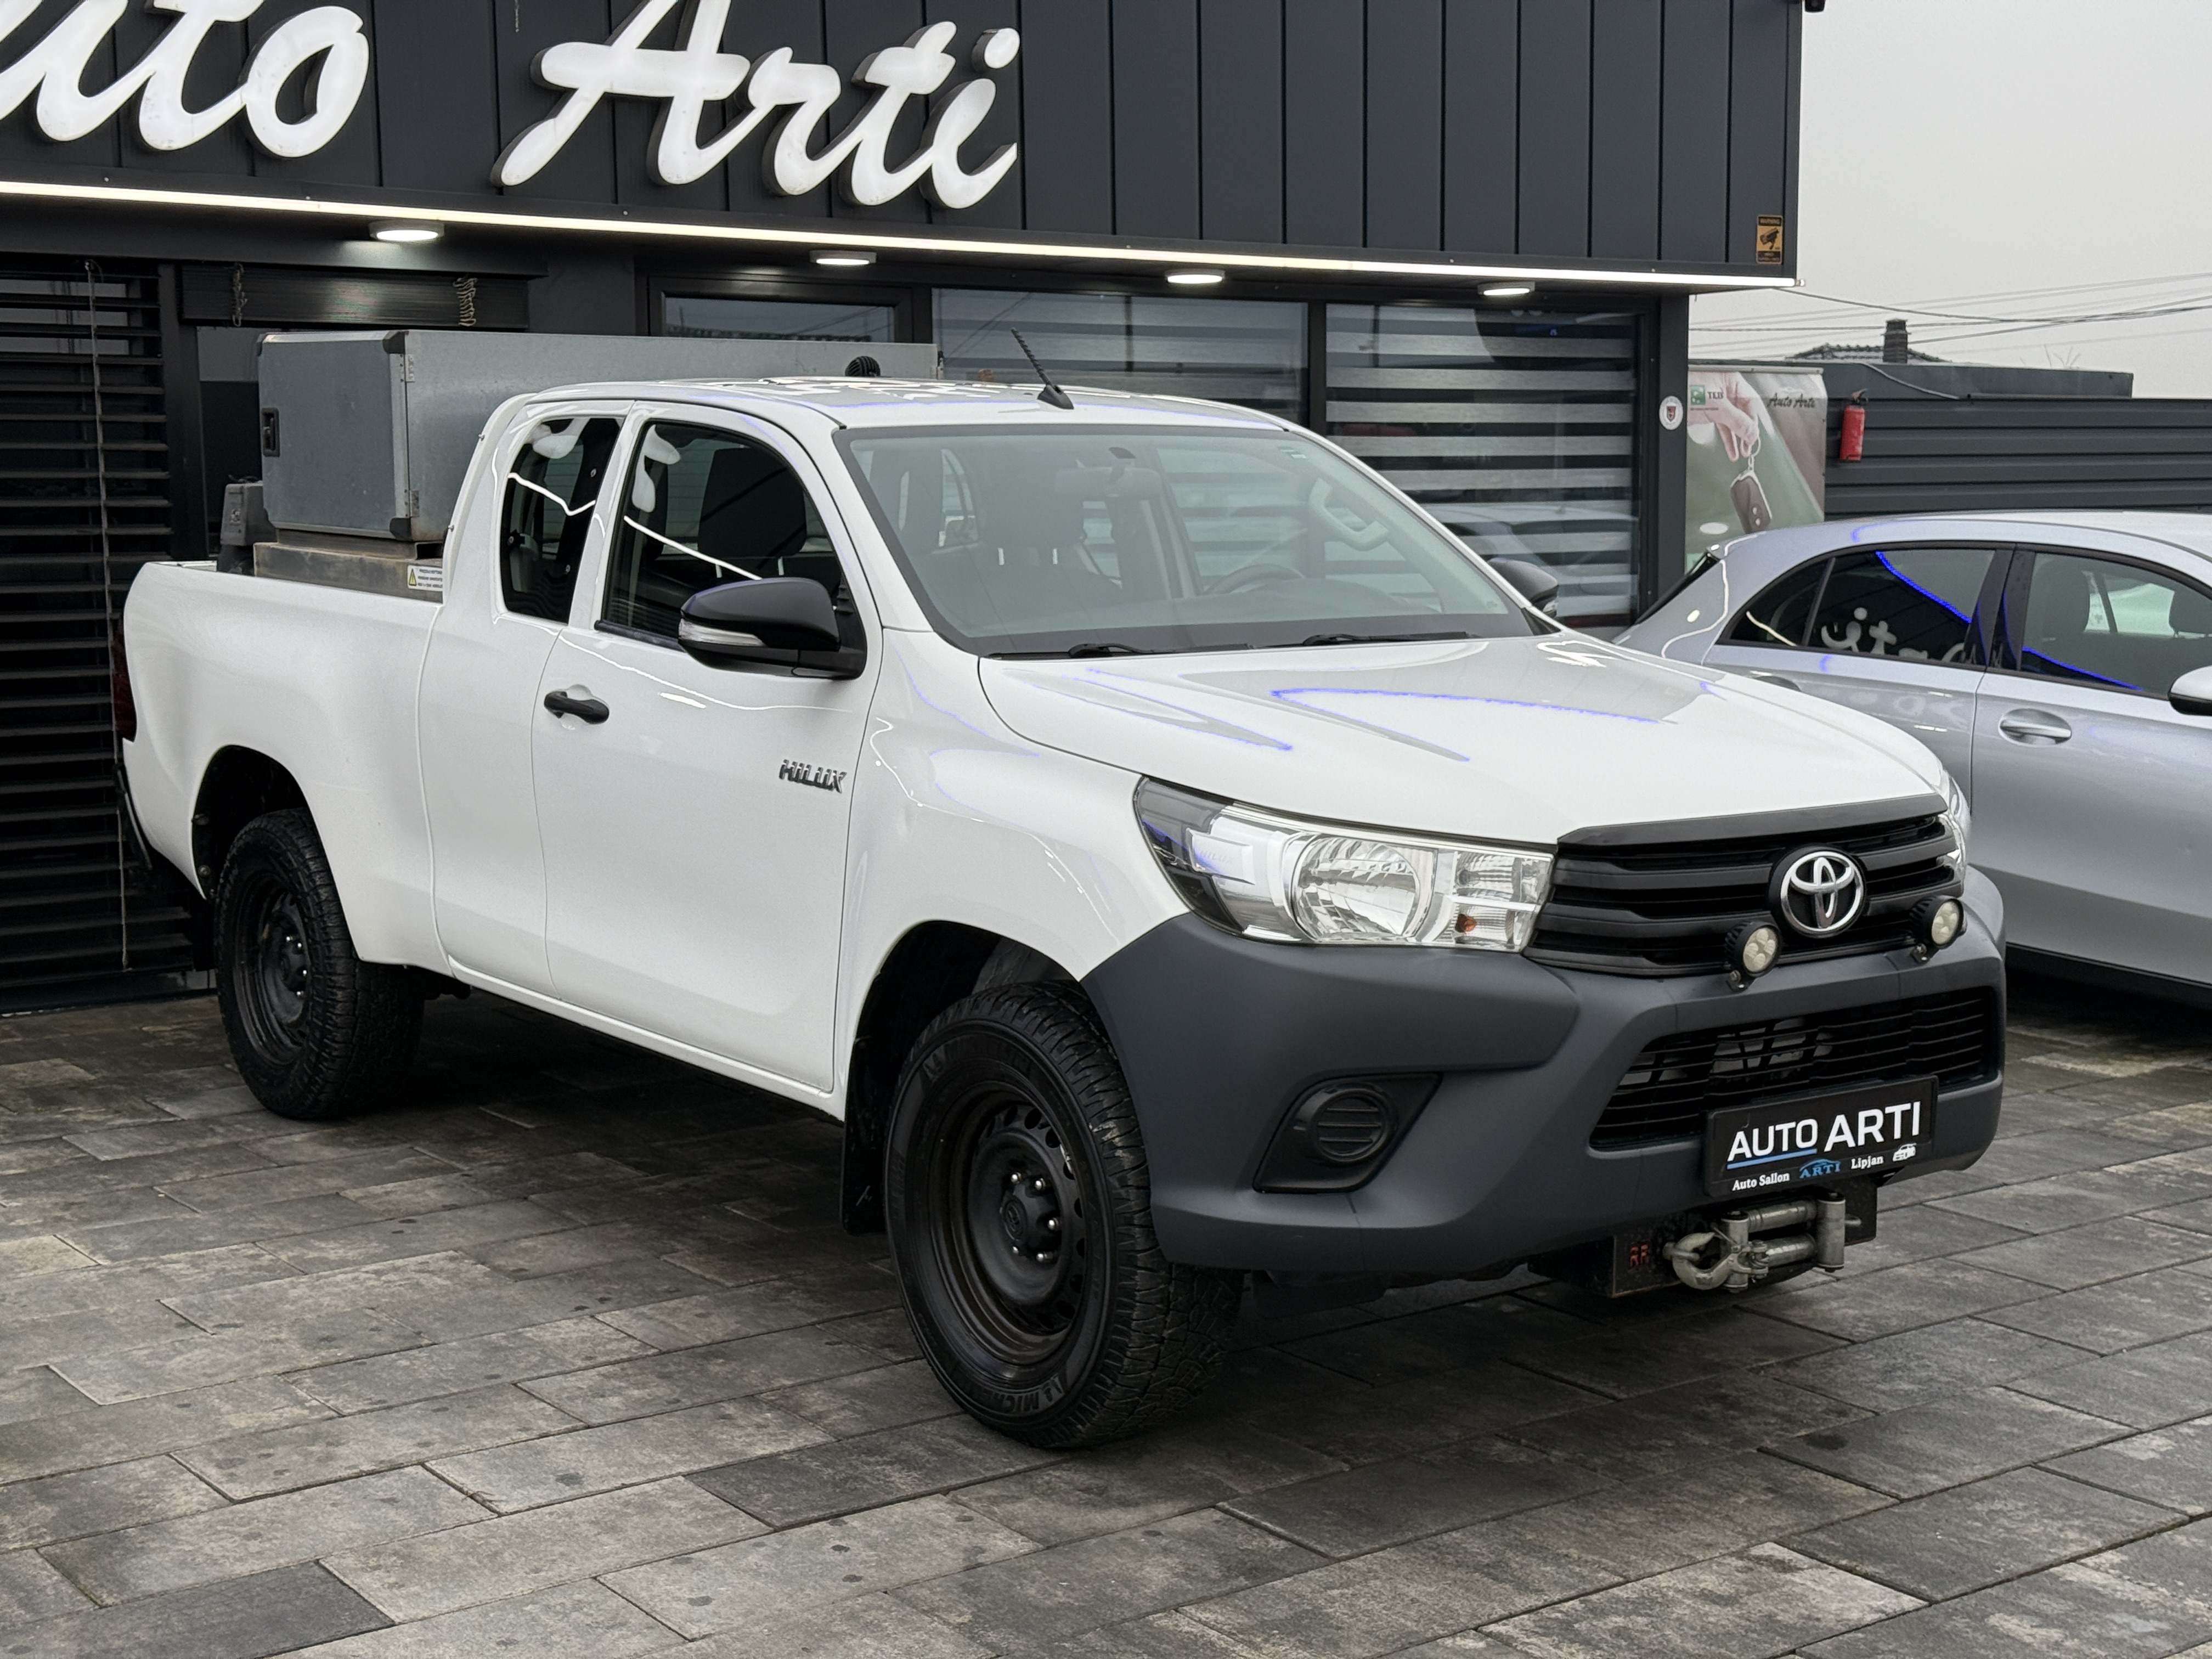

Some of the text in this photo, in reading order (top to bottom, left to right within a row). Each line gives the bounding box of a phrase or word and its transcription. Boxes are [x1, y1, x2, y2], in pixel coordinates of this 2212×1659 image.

[0, 0, 1019, 210] uto Arti
[1767, 392, 1792, 408] Auto
[778, 759, 848, 794] HILUX
[1727, 1101, 1921, 1162] AUTO ARTI
[1732, 1155, 1884, 1191] Auto Sallon ARTI Lipjan
